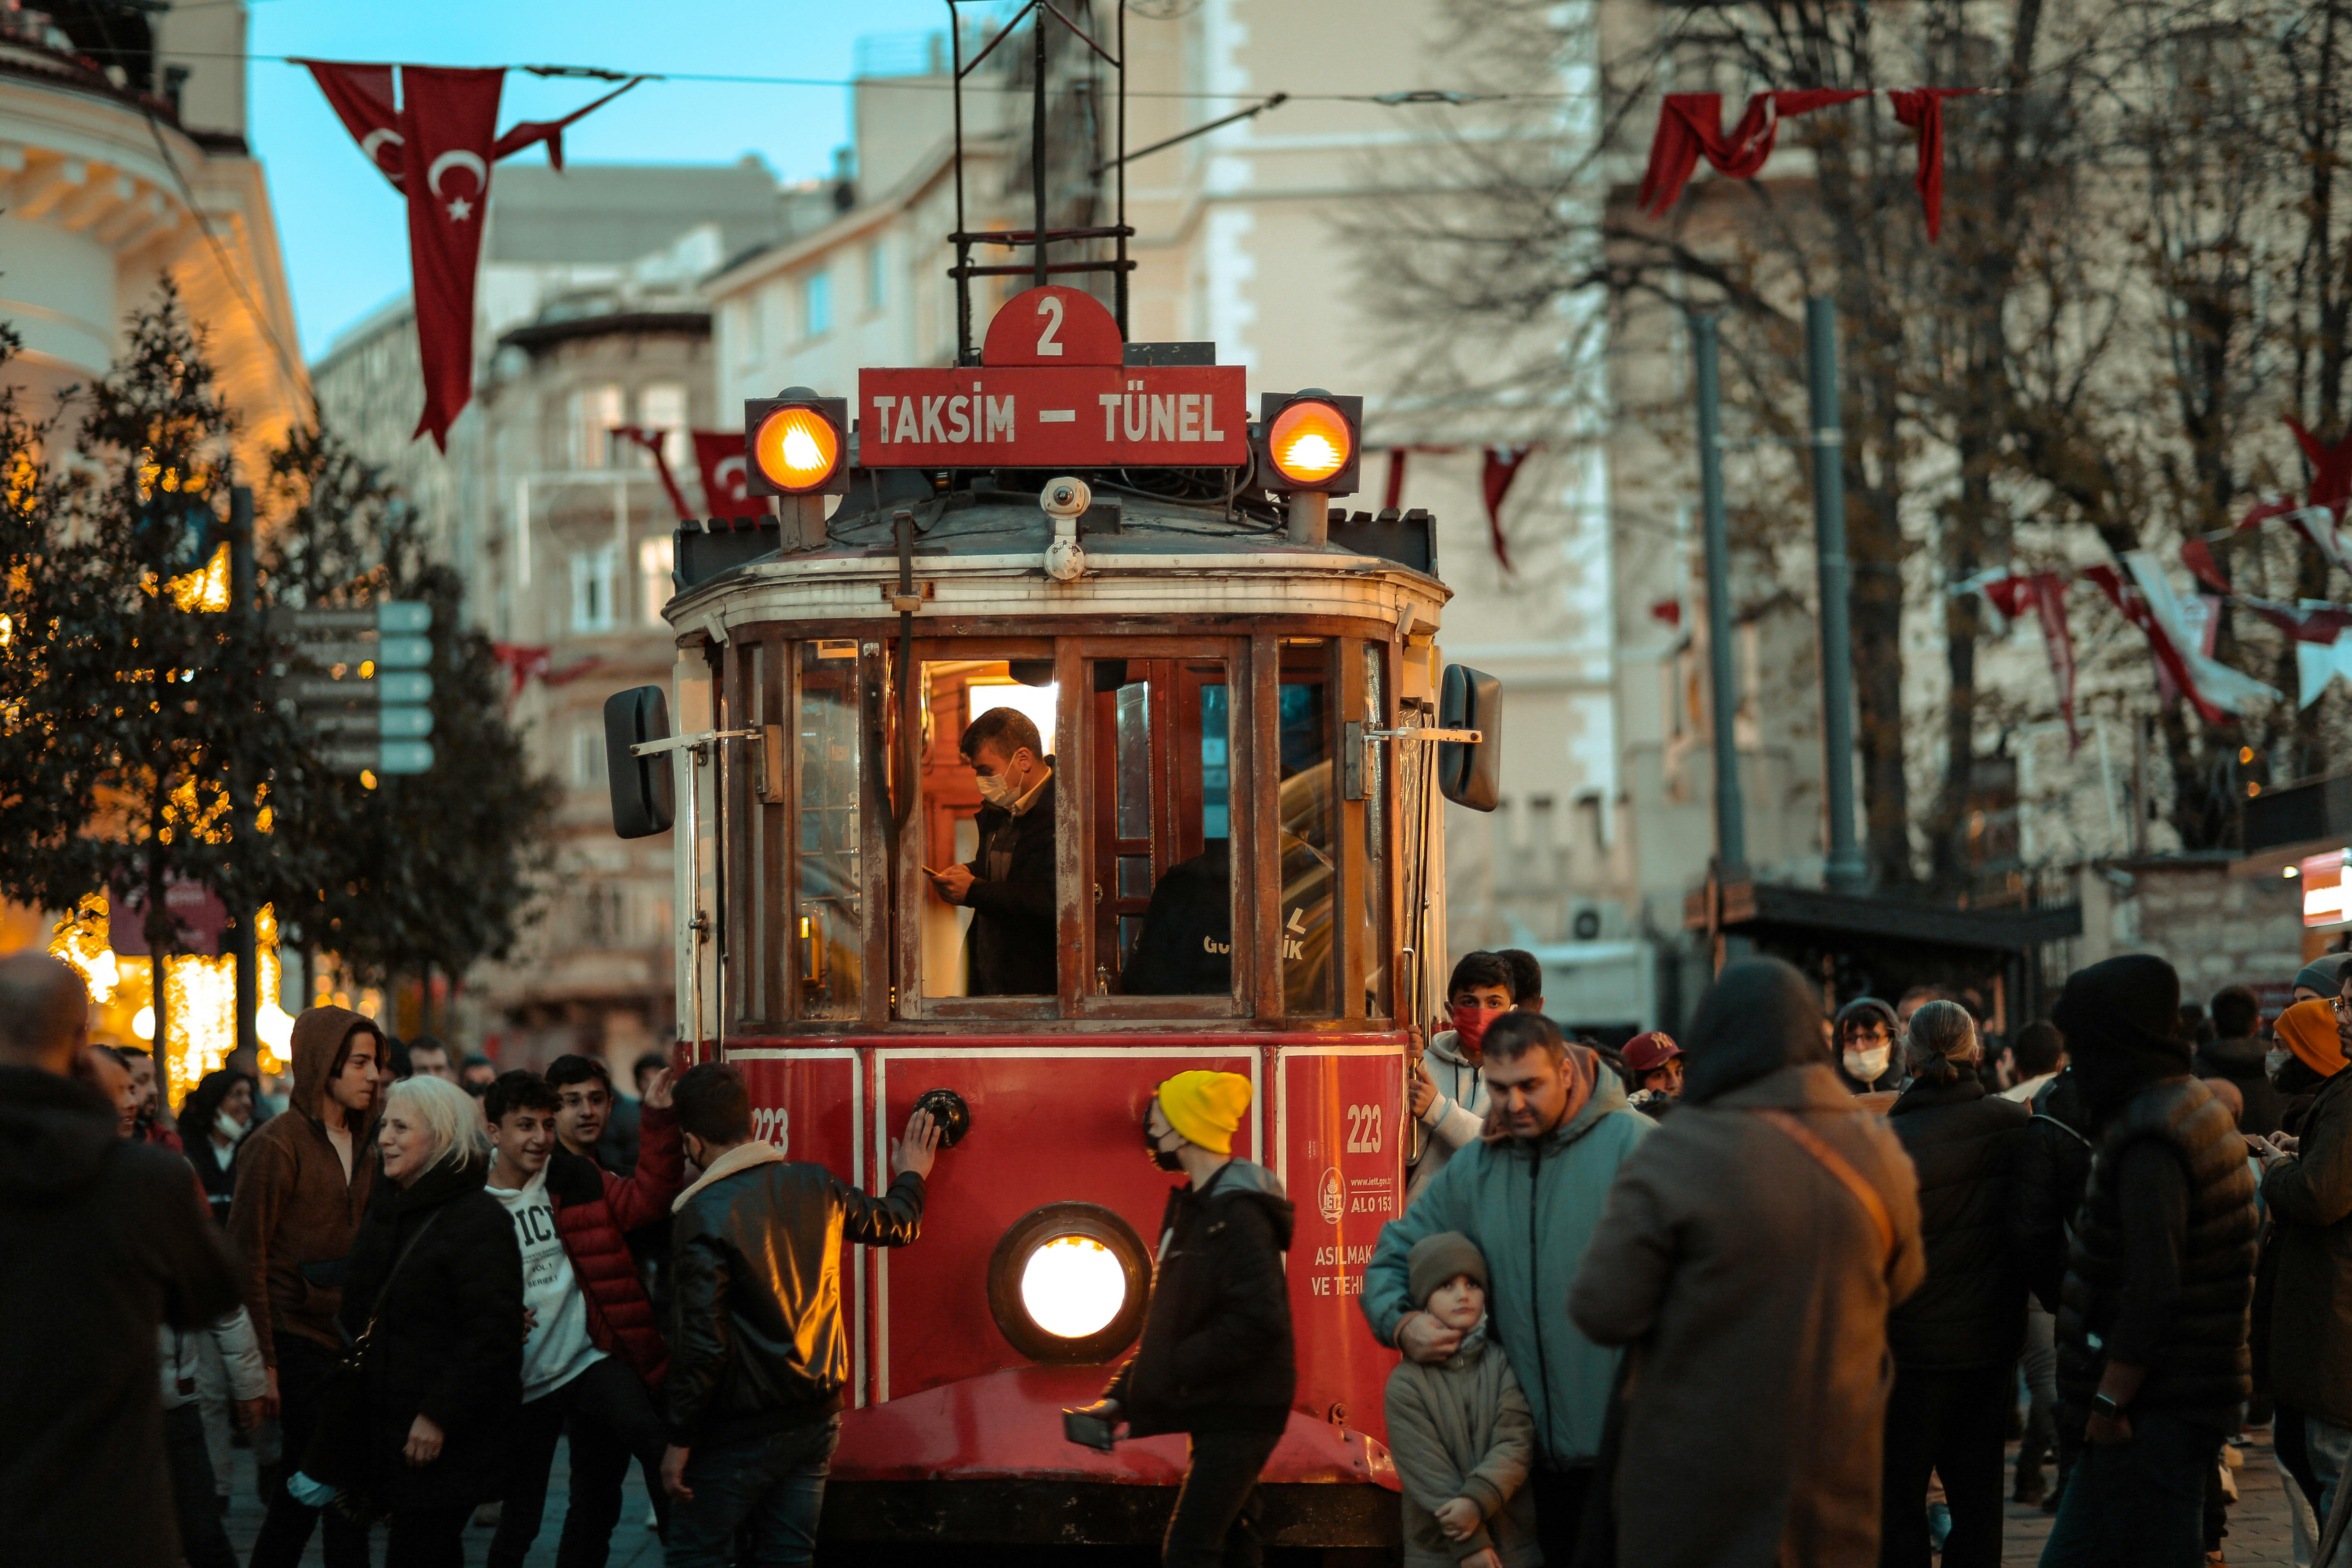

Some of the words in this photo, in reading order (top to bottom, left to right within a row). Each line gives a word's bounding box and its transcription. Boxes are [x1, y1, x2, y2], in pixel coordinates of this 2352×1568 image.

[1037, 296, 1063, 356] 2
[874, 382, 1014, 444] TAKSİM
[1099, 381, 1224, 442] TÜNEL
[1347, 1104, 1381, 1153] 223
[1351, 1197, 1375, 1213] ALO
[1378, 1196, 1392, 1212] 153
[1312, 1277, 1330, 1296] VE
